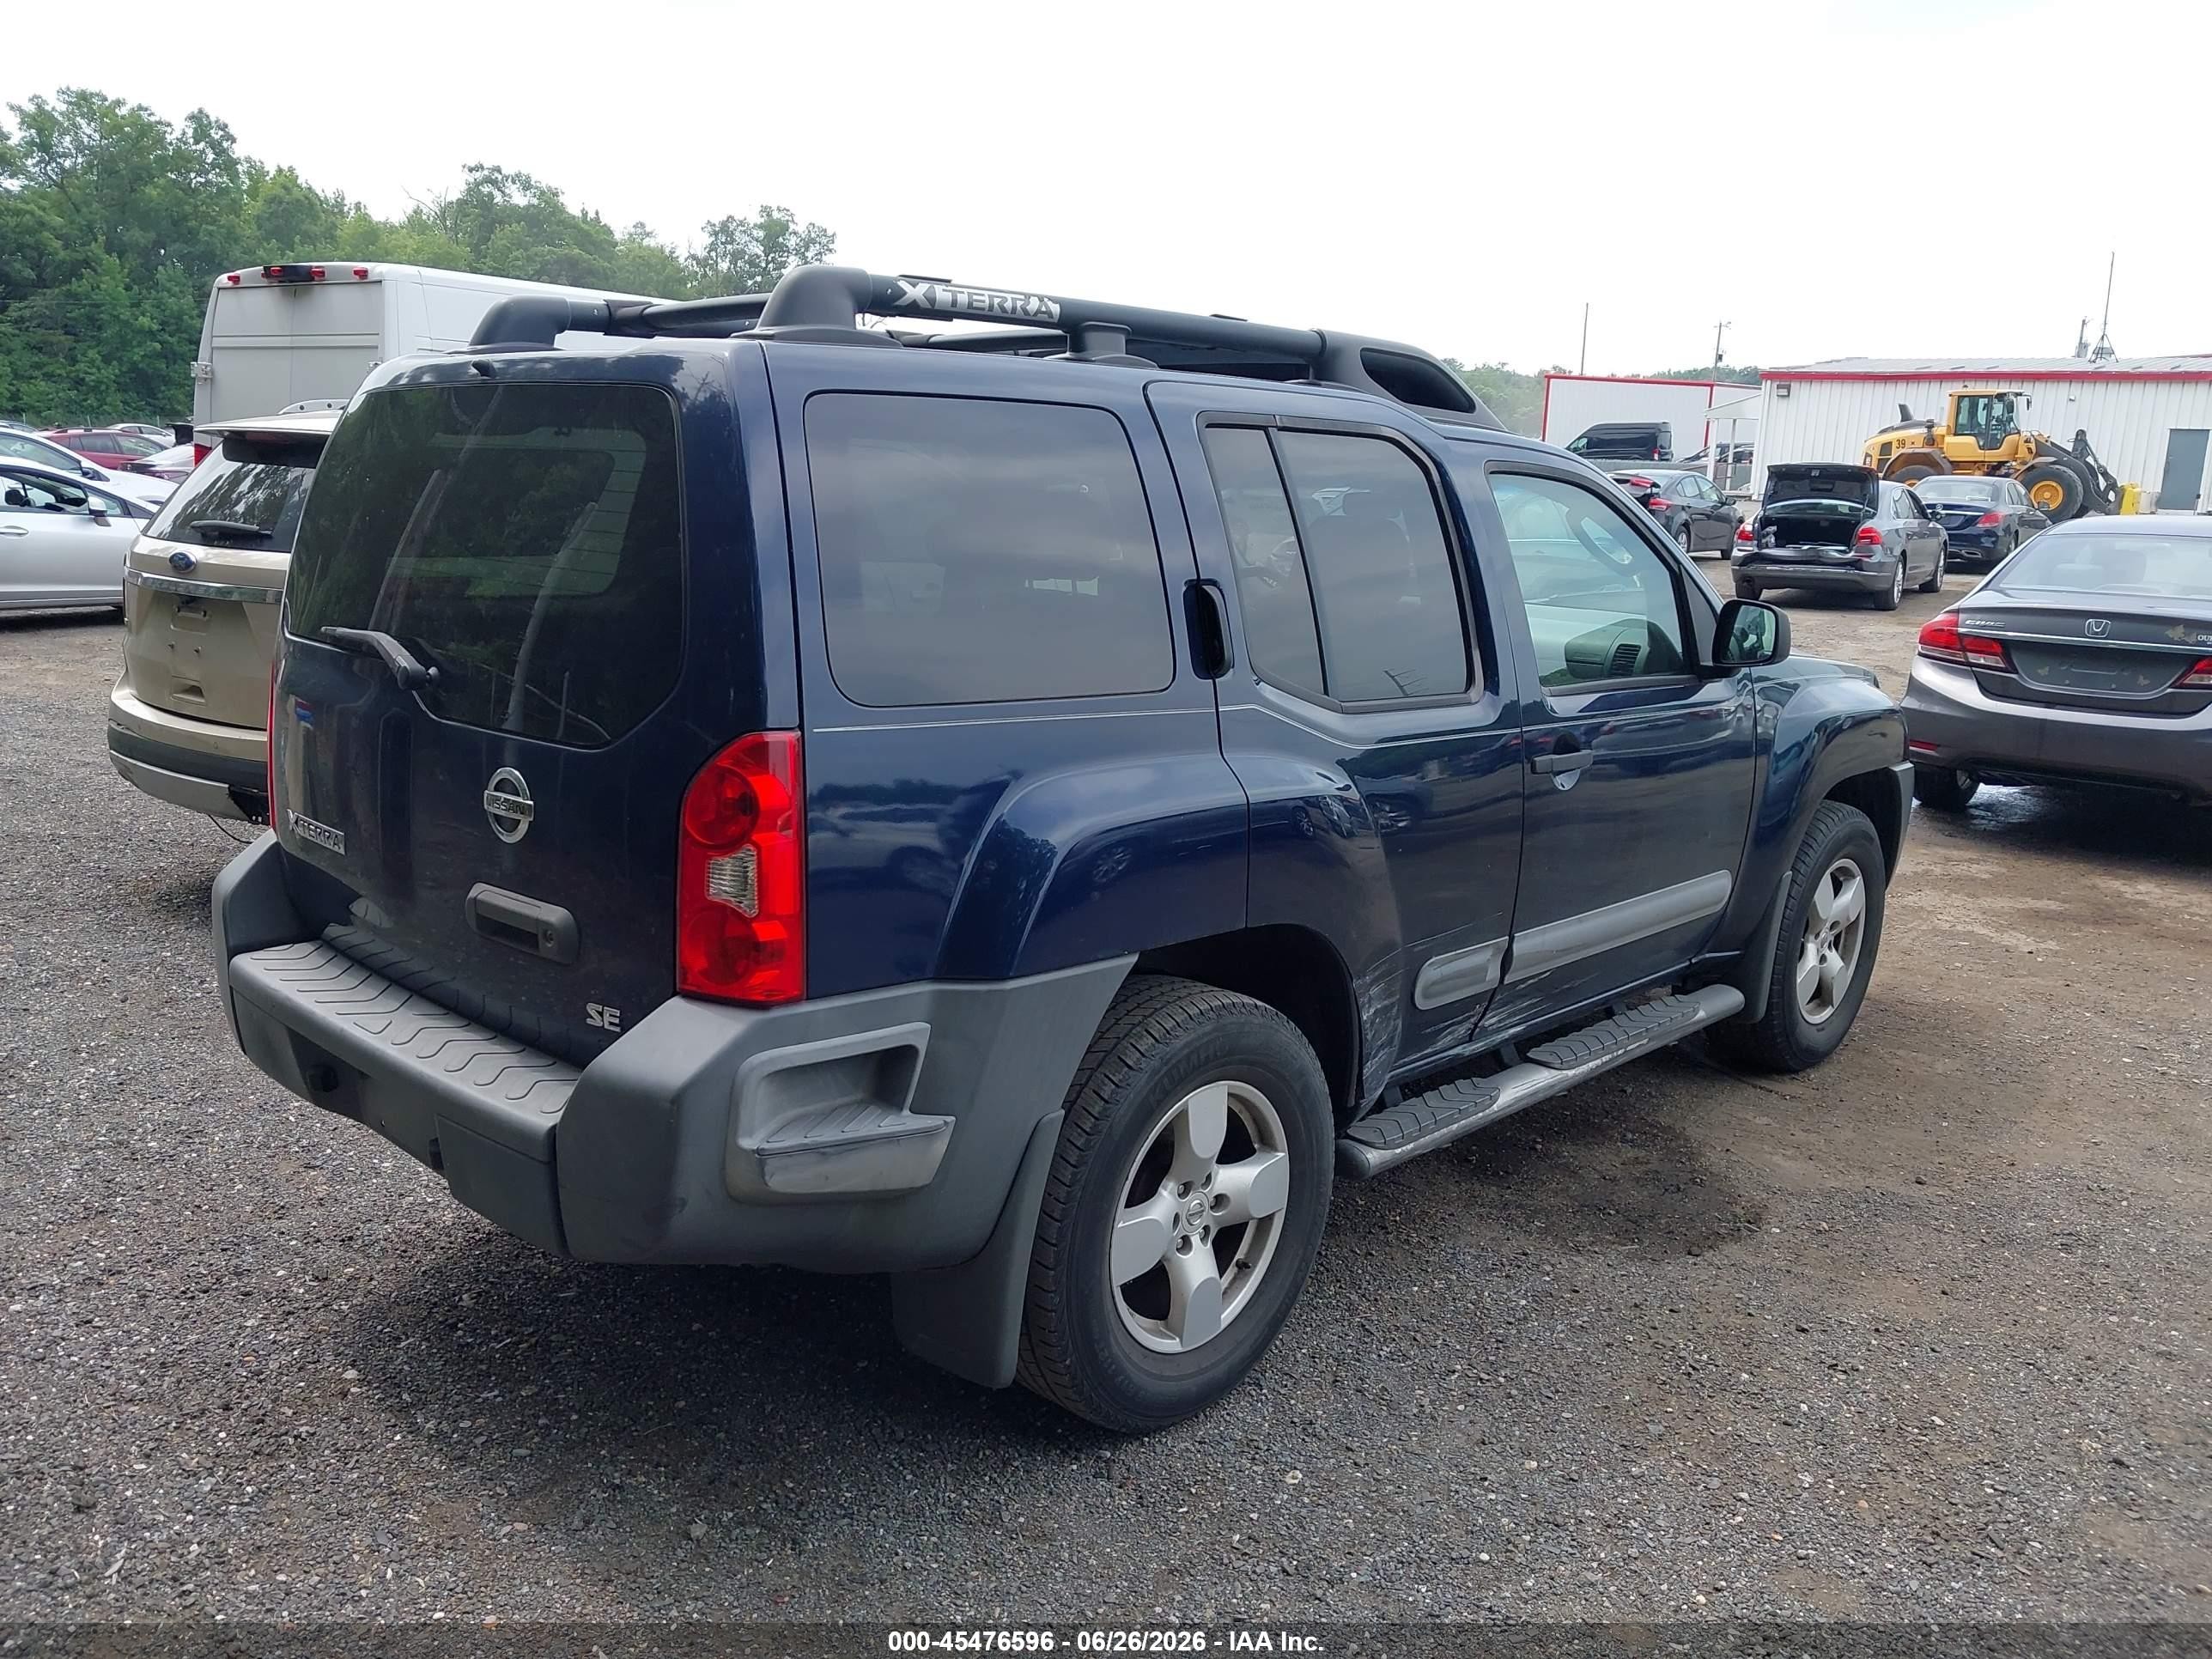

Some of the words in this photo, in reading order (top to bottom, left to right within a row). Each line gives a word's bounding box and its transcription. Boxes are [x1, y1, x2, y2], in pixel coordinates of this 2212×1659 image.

[893, 279, 1060, 321] XTERRA
[1895, 439, 1906, 449] 39
[486, 793, 531, 818] NISSAN
[286, 809, 345, 854] XTERRA
[586, 1002, 622, 1033] SE
